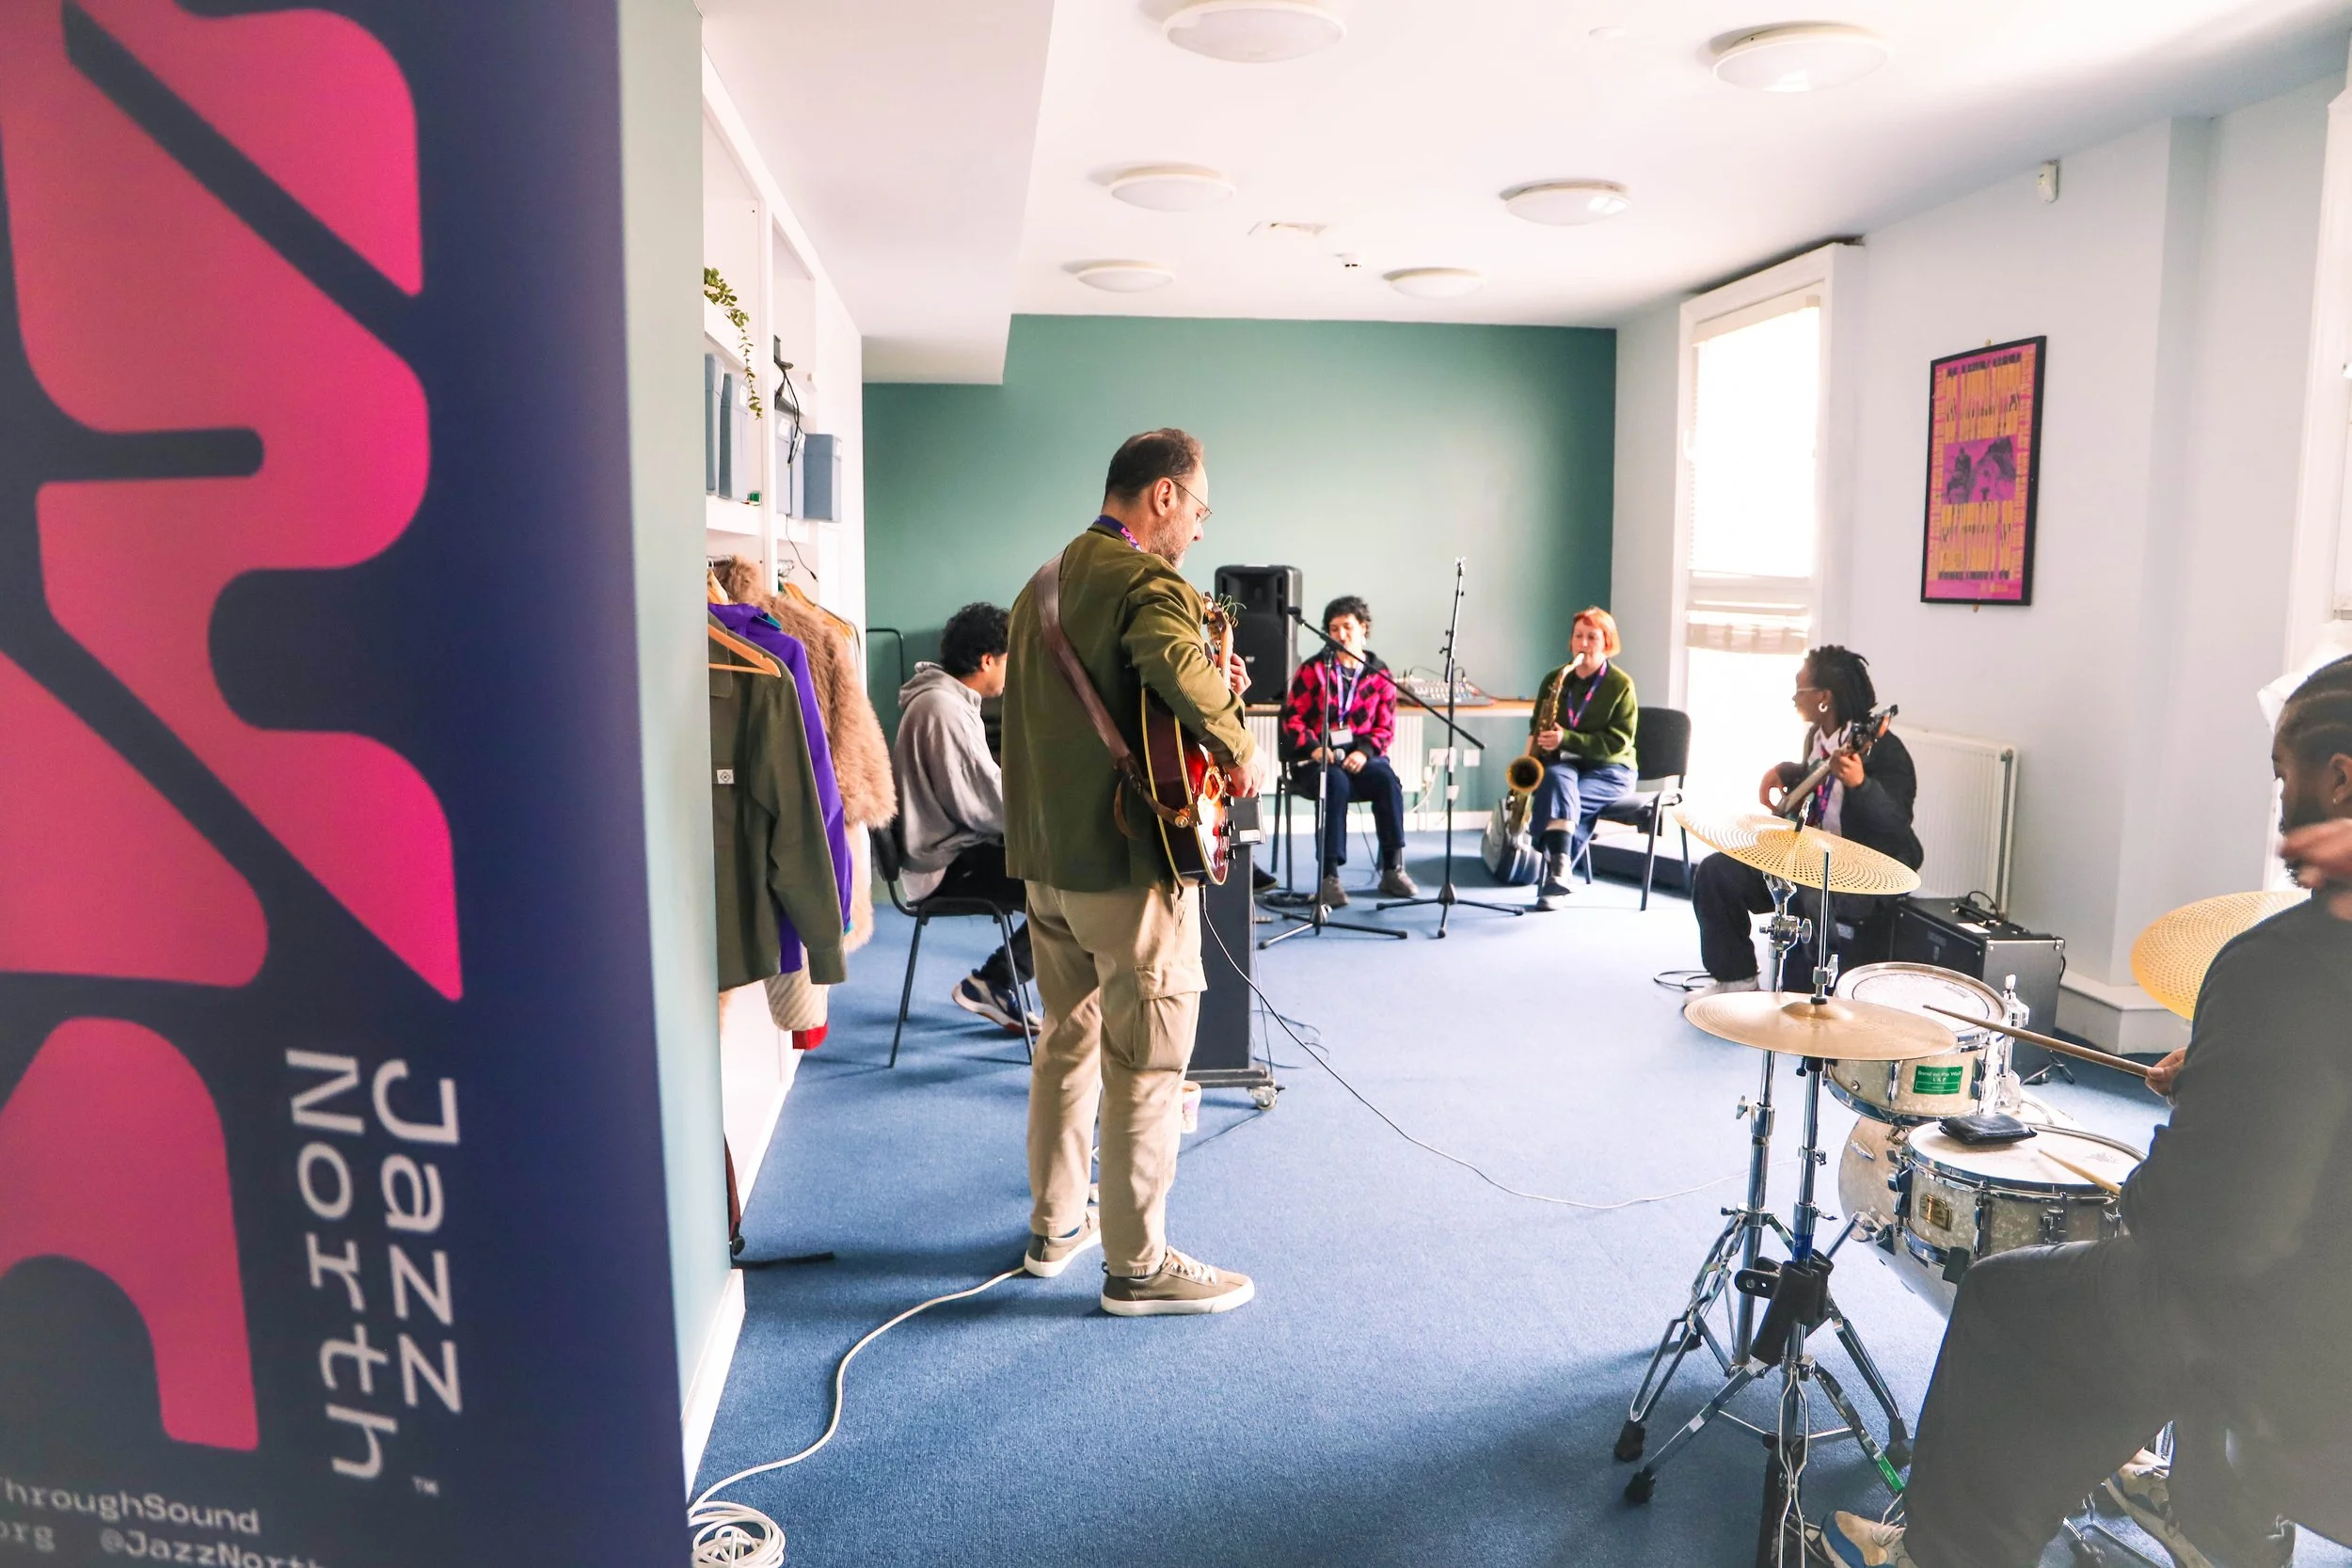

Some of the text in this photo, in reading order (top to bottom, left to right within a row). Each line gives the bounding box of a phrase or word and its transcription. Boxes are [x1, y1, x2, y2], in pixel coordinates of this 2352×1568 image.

[285, 1048, 398, 1481] North
[372, 1058, 462, 1415] Jazz
[0, 1476, 262, 1536] hroughSound
